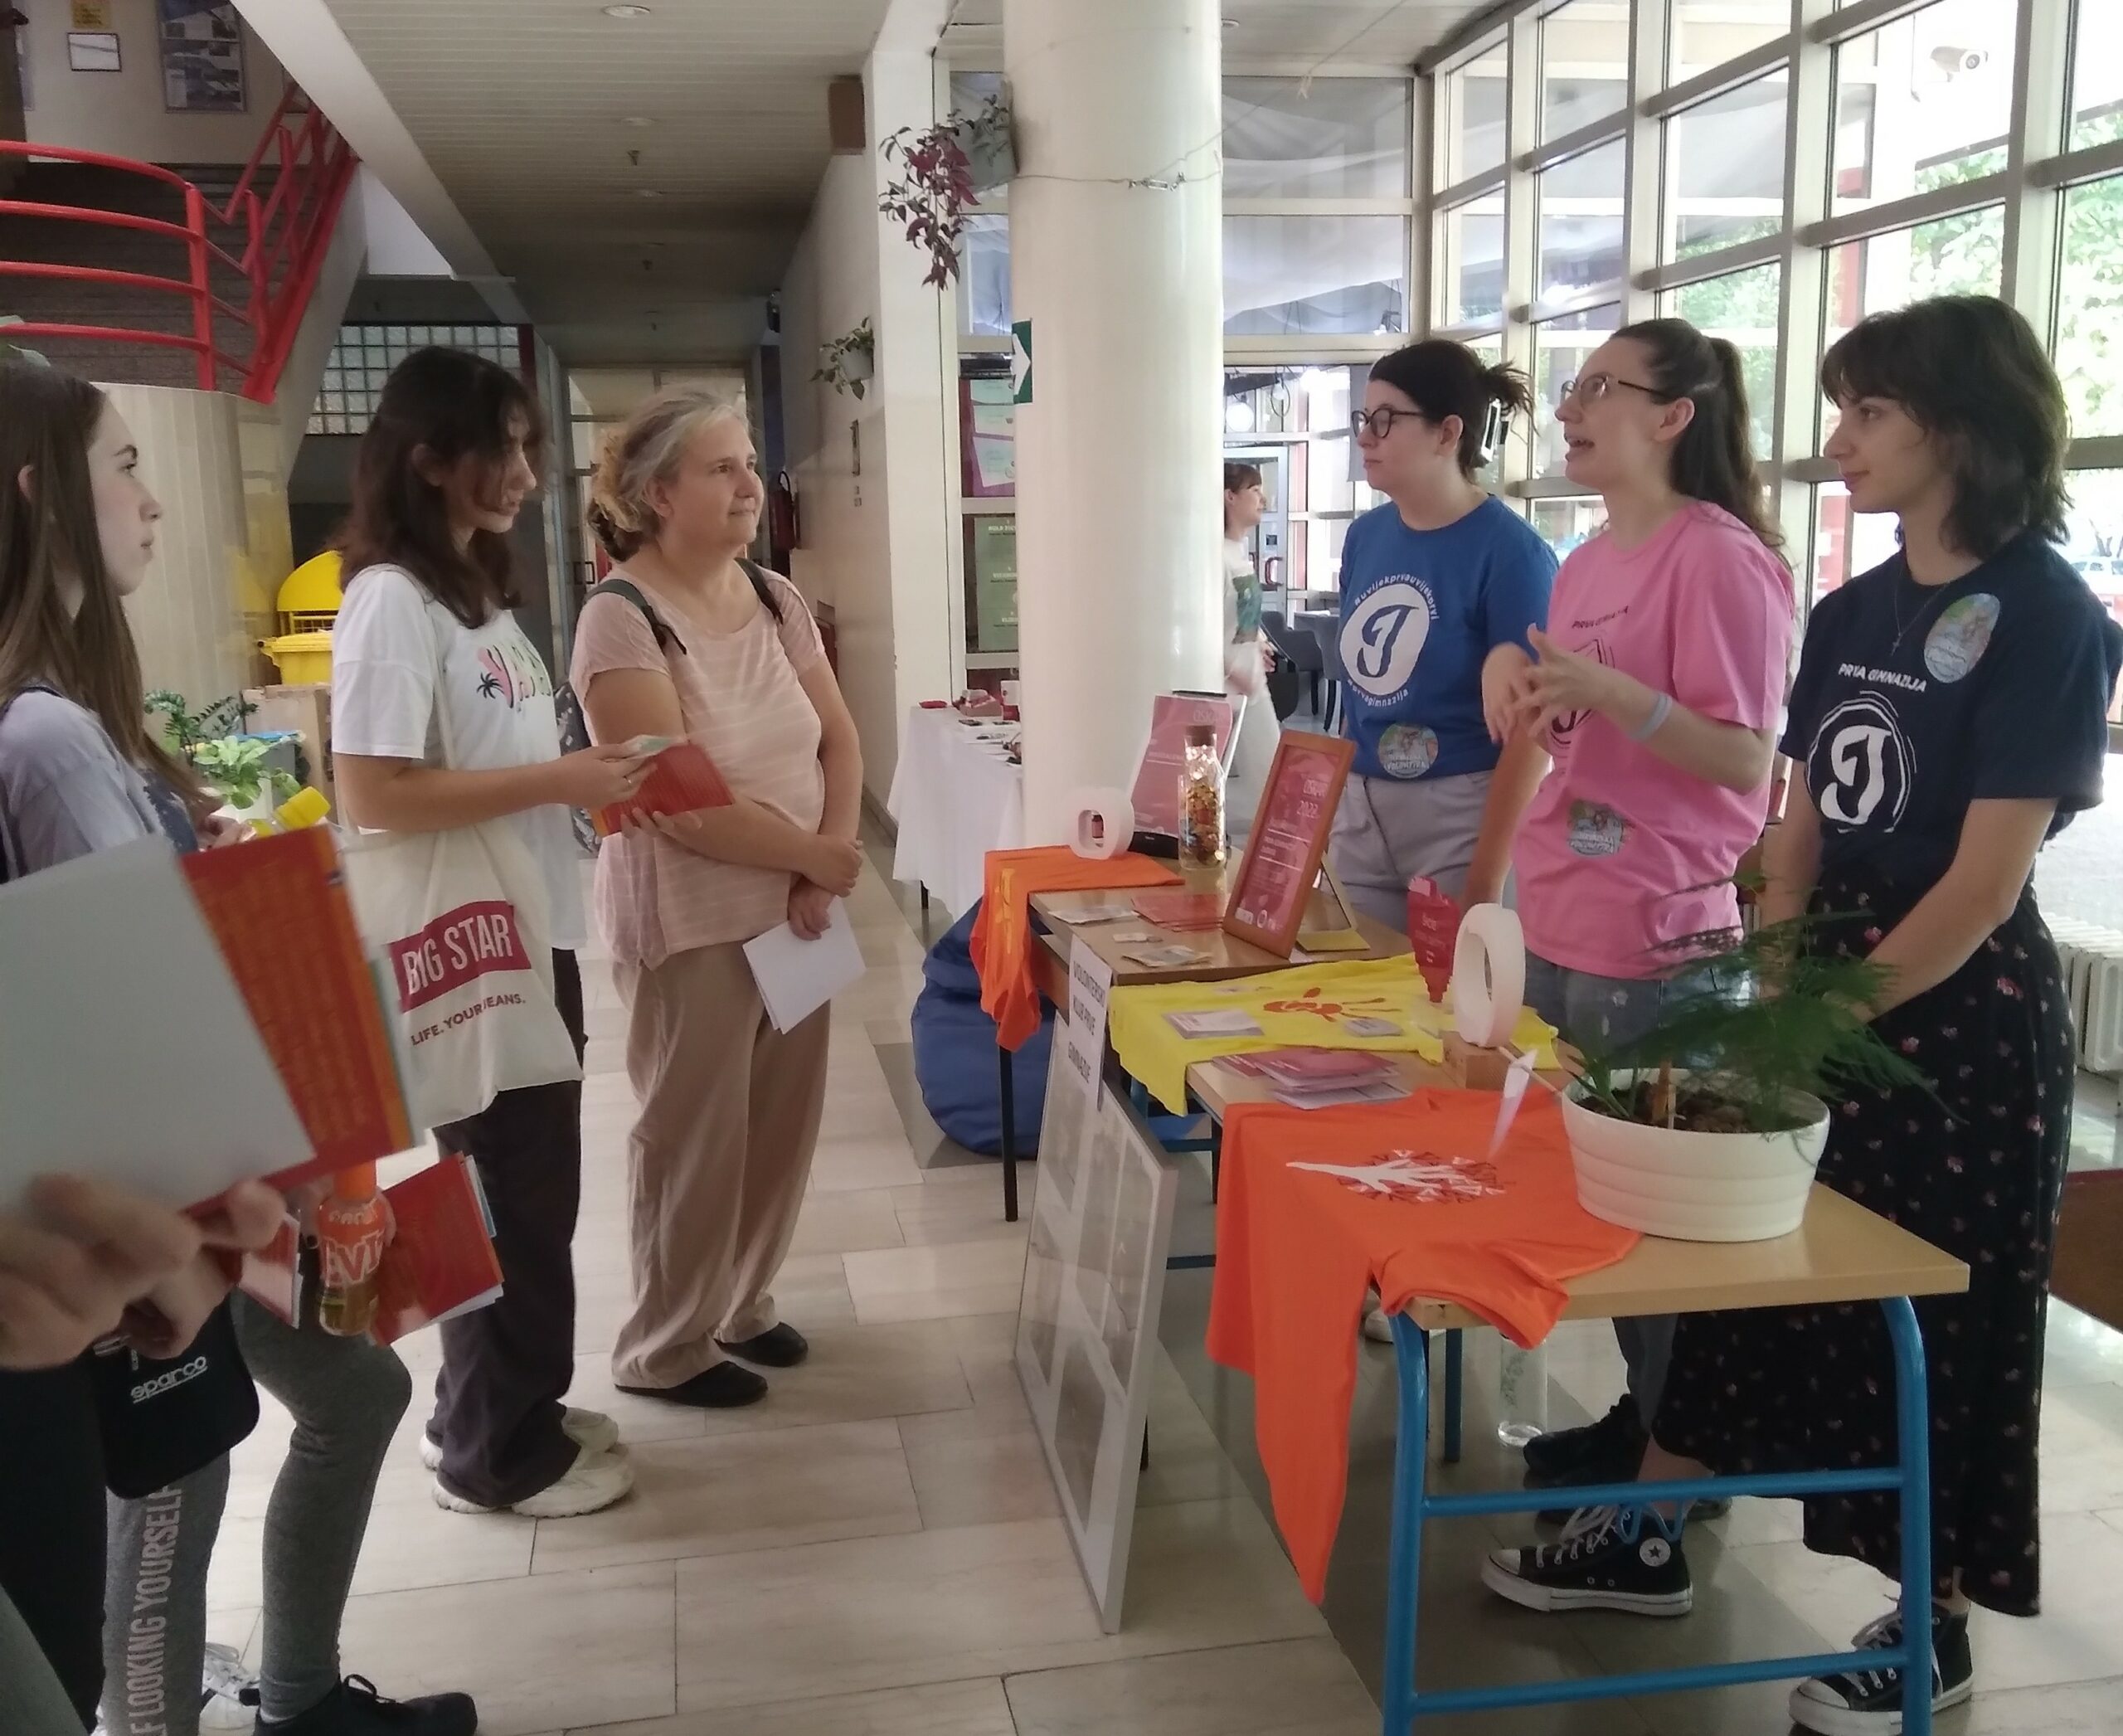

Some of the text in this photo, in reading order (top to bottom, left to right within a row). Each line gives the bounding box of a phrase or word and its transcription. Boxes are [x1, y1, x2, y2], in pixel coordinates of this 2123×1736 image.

[1838, 663, 1927, 693] PRVA GIMNAZIJA
[401, 914, 513, 995] BIG STAR
[411, 1024, 445, 1046] LIFE.
[442, 1004, 483, 1029] YOUR
[130, 1355, 206, 1399] sparco
[125, 1616, 166, 1718] LOOKING
